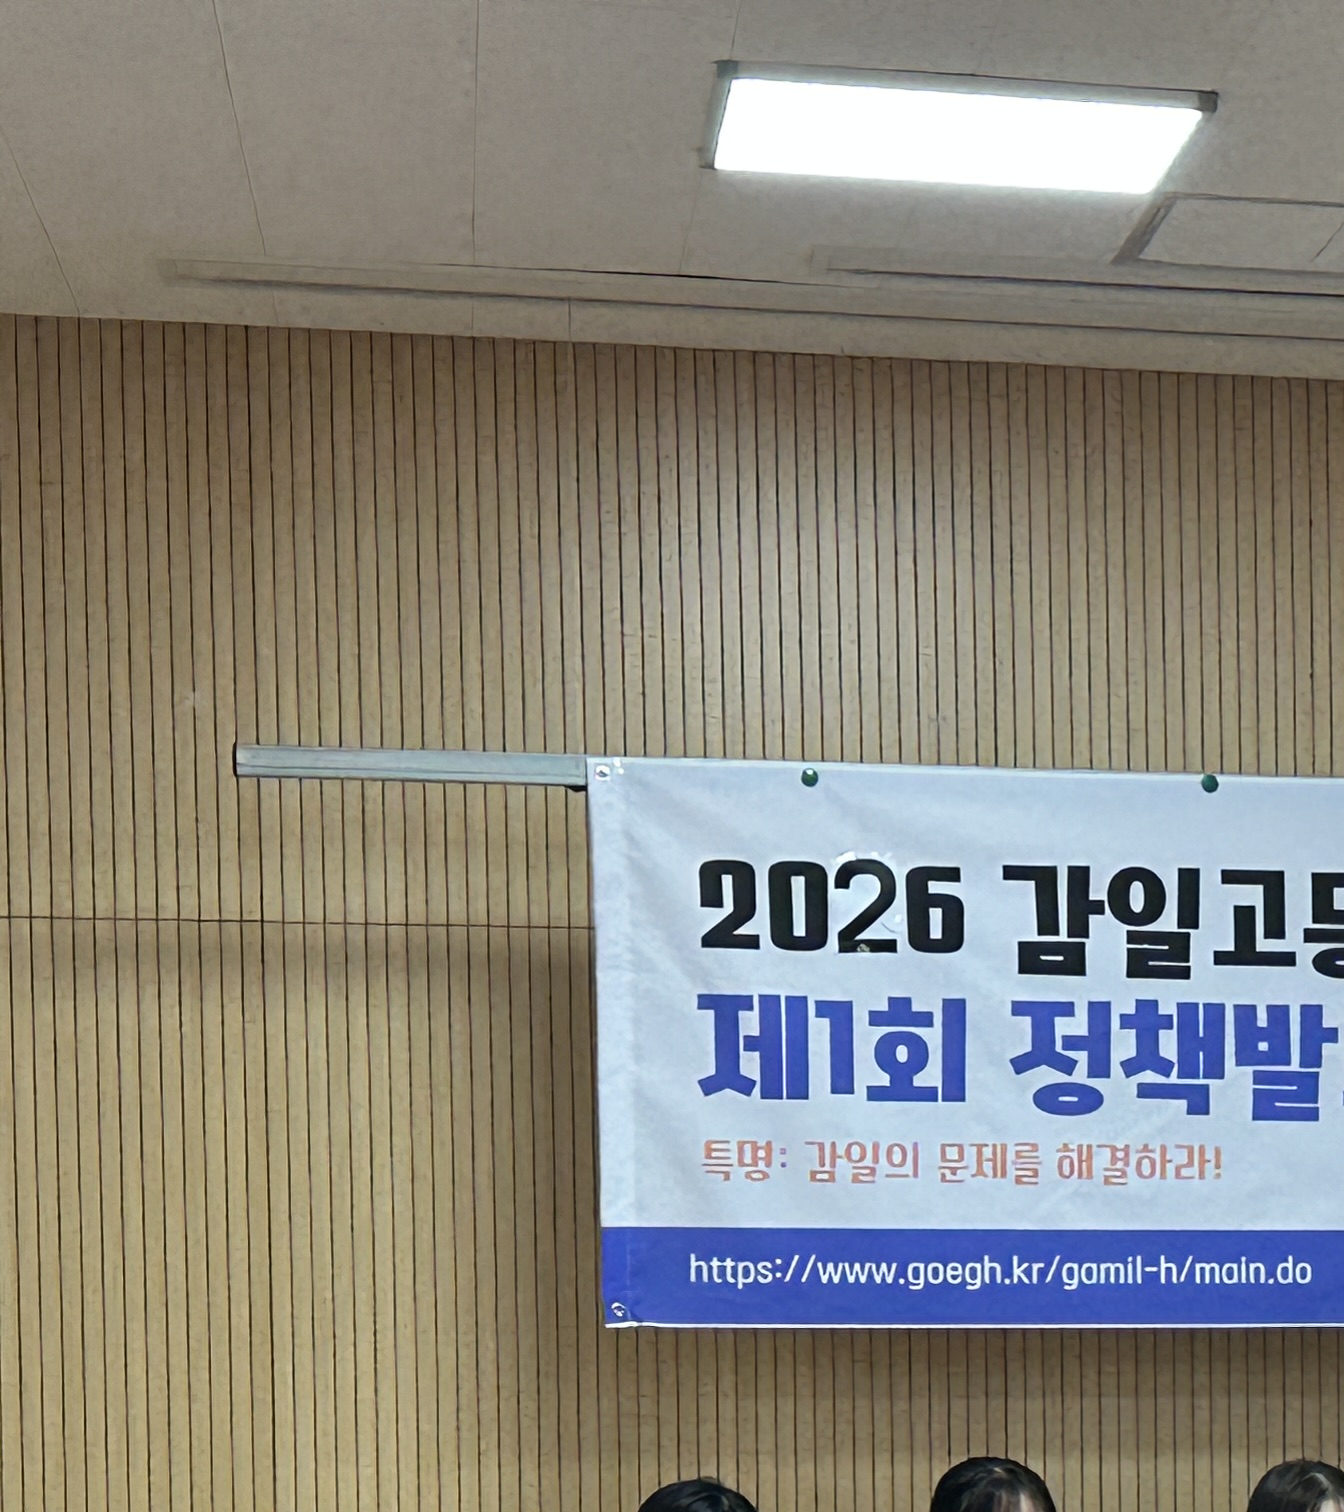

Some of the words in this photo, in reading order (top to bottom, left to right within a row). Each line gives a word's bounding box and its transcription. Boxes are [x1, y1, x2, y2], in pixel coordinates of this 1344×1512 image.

[699, 859, 964, 953] 2026
[697, 994, 966, 1102] 제1회
[702, 1140, 787, 1181] 특명:
[805, 1141, 918, 1183] 감일의
[938, 1143, 1041, 1185] 문제를
[1056, 1143, 1221, 1186] 해결하라!
[690, 1254, 1311, 1290] https://www.goegh.kr/gamil-h/main.do
